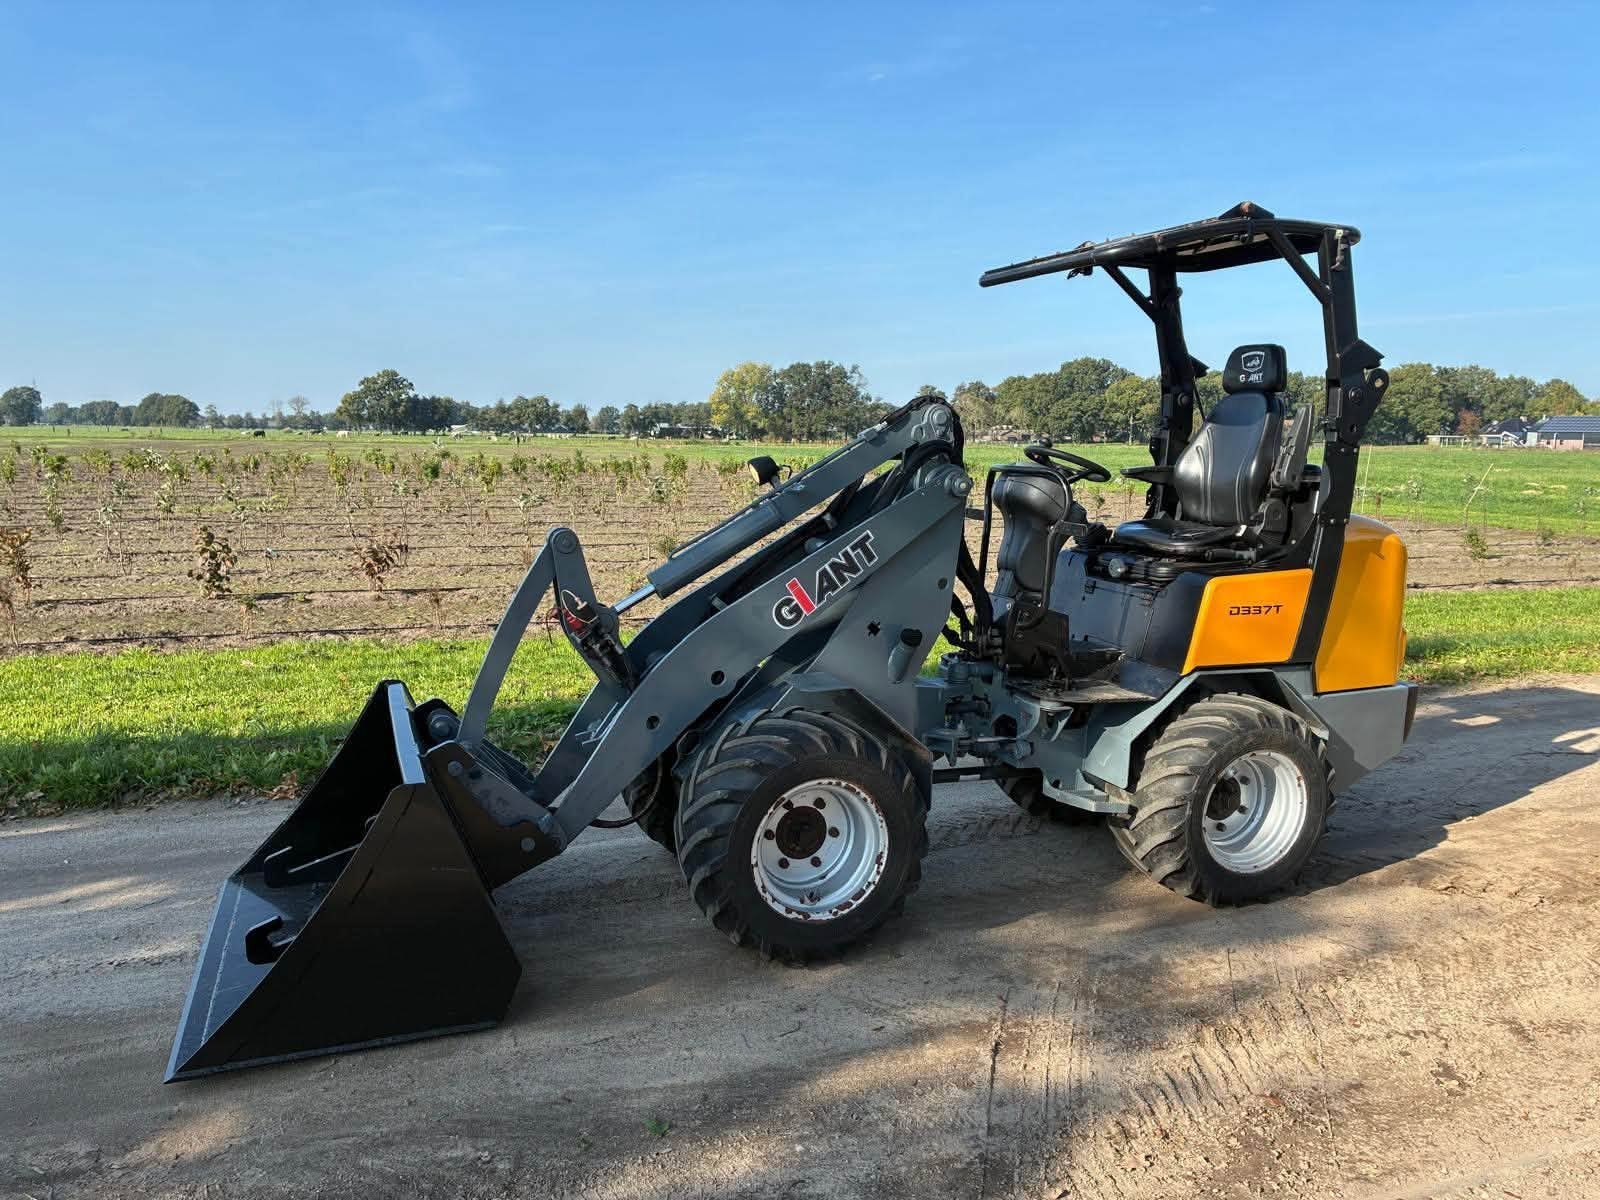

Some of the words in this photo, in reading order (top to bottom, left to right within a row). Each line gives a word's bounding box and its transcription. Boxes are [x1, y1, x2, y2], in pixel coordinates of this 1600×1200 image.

[1240, 373, 1263, 382] GANT
[773, 529, 878, 629] GIANT
[1229, 605, 1284, 615] D337T
